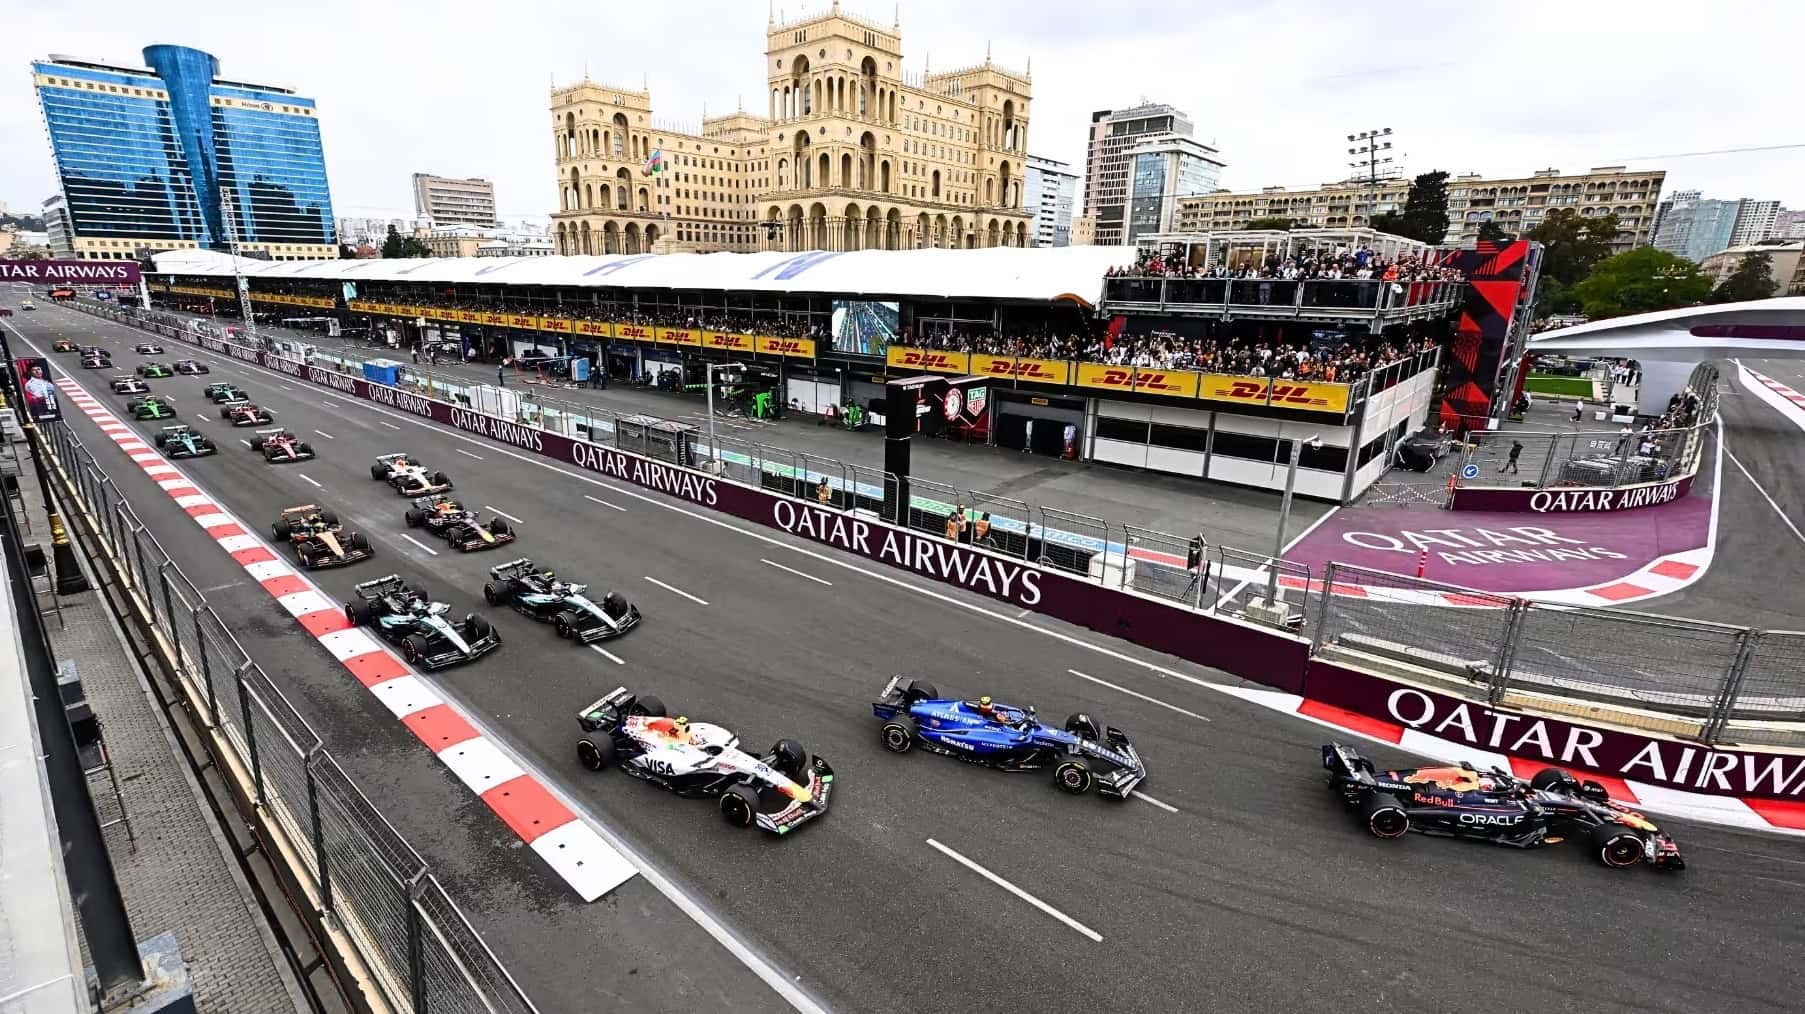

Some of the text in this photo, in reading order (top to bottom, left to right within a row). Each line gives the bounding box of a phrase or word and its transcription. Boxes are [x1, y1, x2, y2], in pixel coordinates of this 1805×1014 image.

[0, 264, 128, 278] TAR AIRWAYS
[582, 323, 603, 334] DHL
[623, 327, 645, 338] DHL
[665, 331, 692, 342] DHL
[713, 335, 743, 347] DHL
[768, 340, 801, 353] DHL
[904, 352, 951, 368] DHL
[989, 360, 1044, 377] DHL
[308, 367, 356, 394] QATAR AIRWAYS
[1103, 370, 1169, 389] DHL
[368, 383, 432, 417] QATAR AIRWAYS
[1230, 382, 1317, 404] DHL
[450, 407, 543, 452] QATAR AIRWAYS
[572, 442, 629, 479] QATAR
[633, 459, 717, 506] AIRWAYS
[1530, 482, 1678, 513] QATAR AIRWAYS
[1342, 526, 1588, 555] QATAR
[773, 499, 1042, 606] QATAR AIRWAYS
[1437, 546, 1628, 566] AIRWAYS
[1387, 688, 1604, 768] QATAR
[940, 735, 975, 751] KOMATSU
[644, 757, 676, 775] VISA
[1377, 781, 1412, 791] HONDA
[1414, 792, 1454, 808] Red Bull
[1459, 813, 1526, 826] ORACLE
